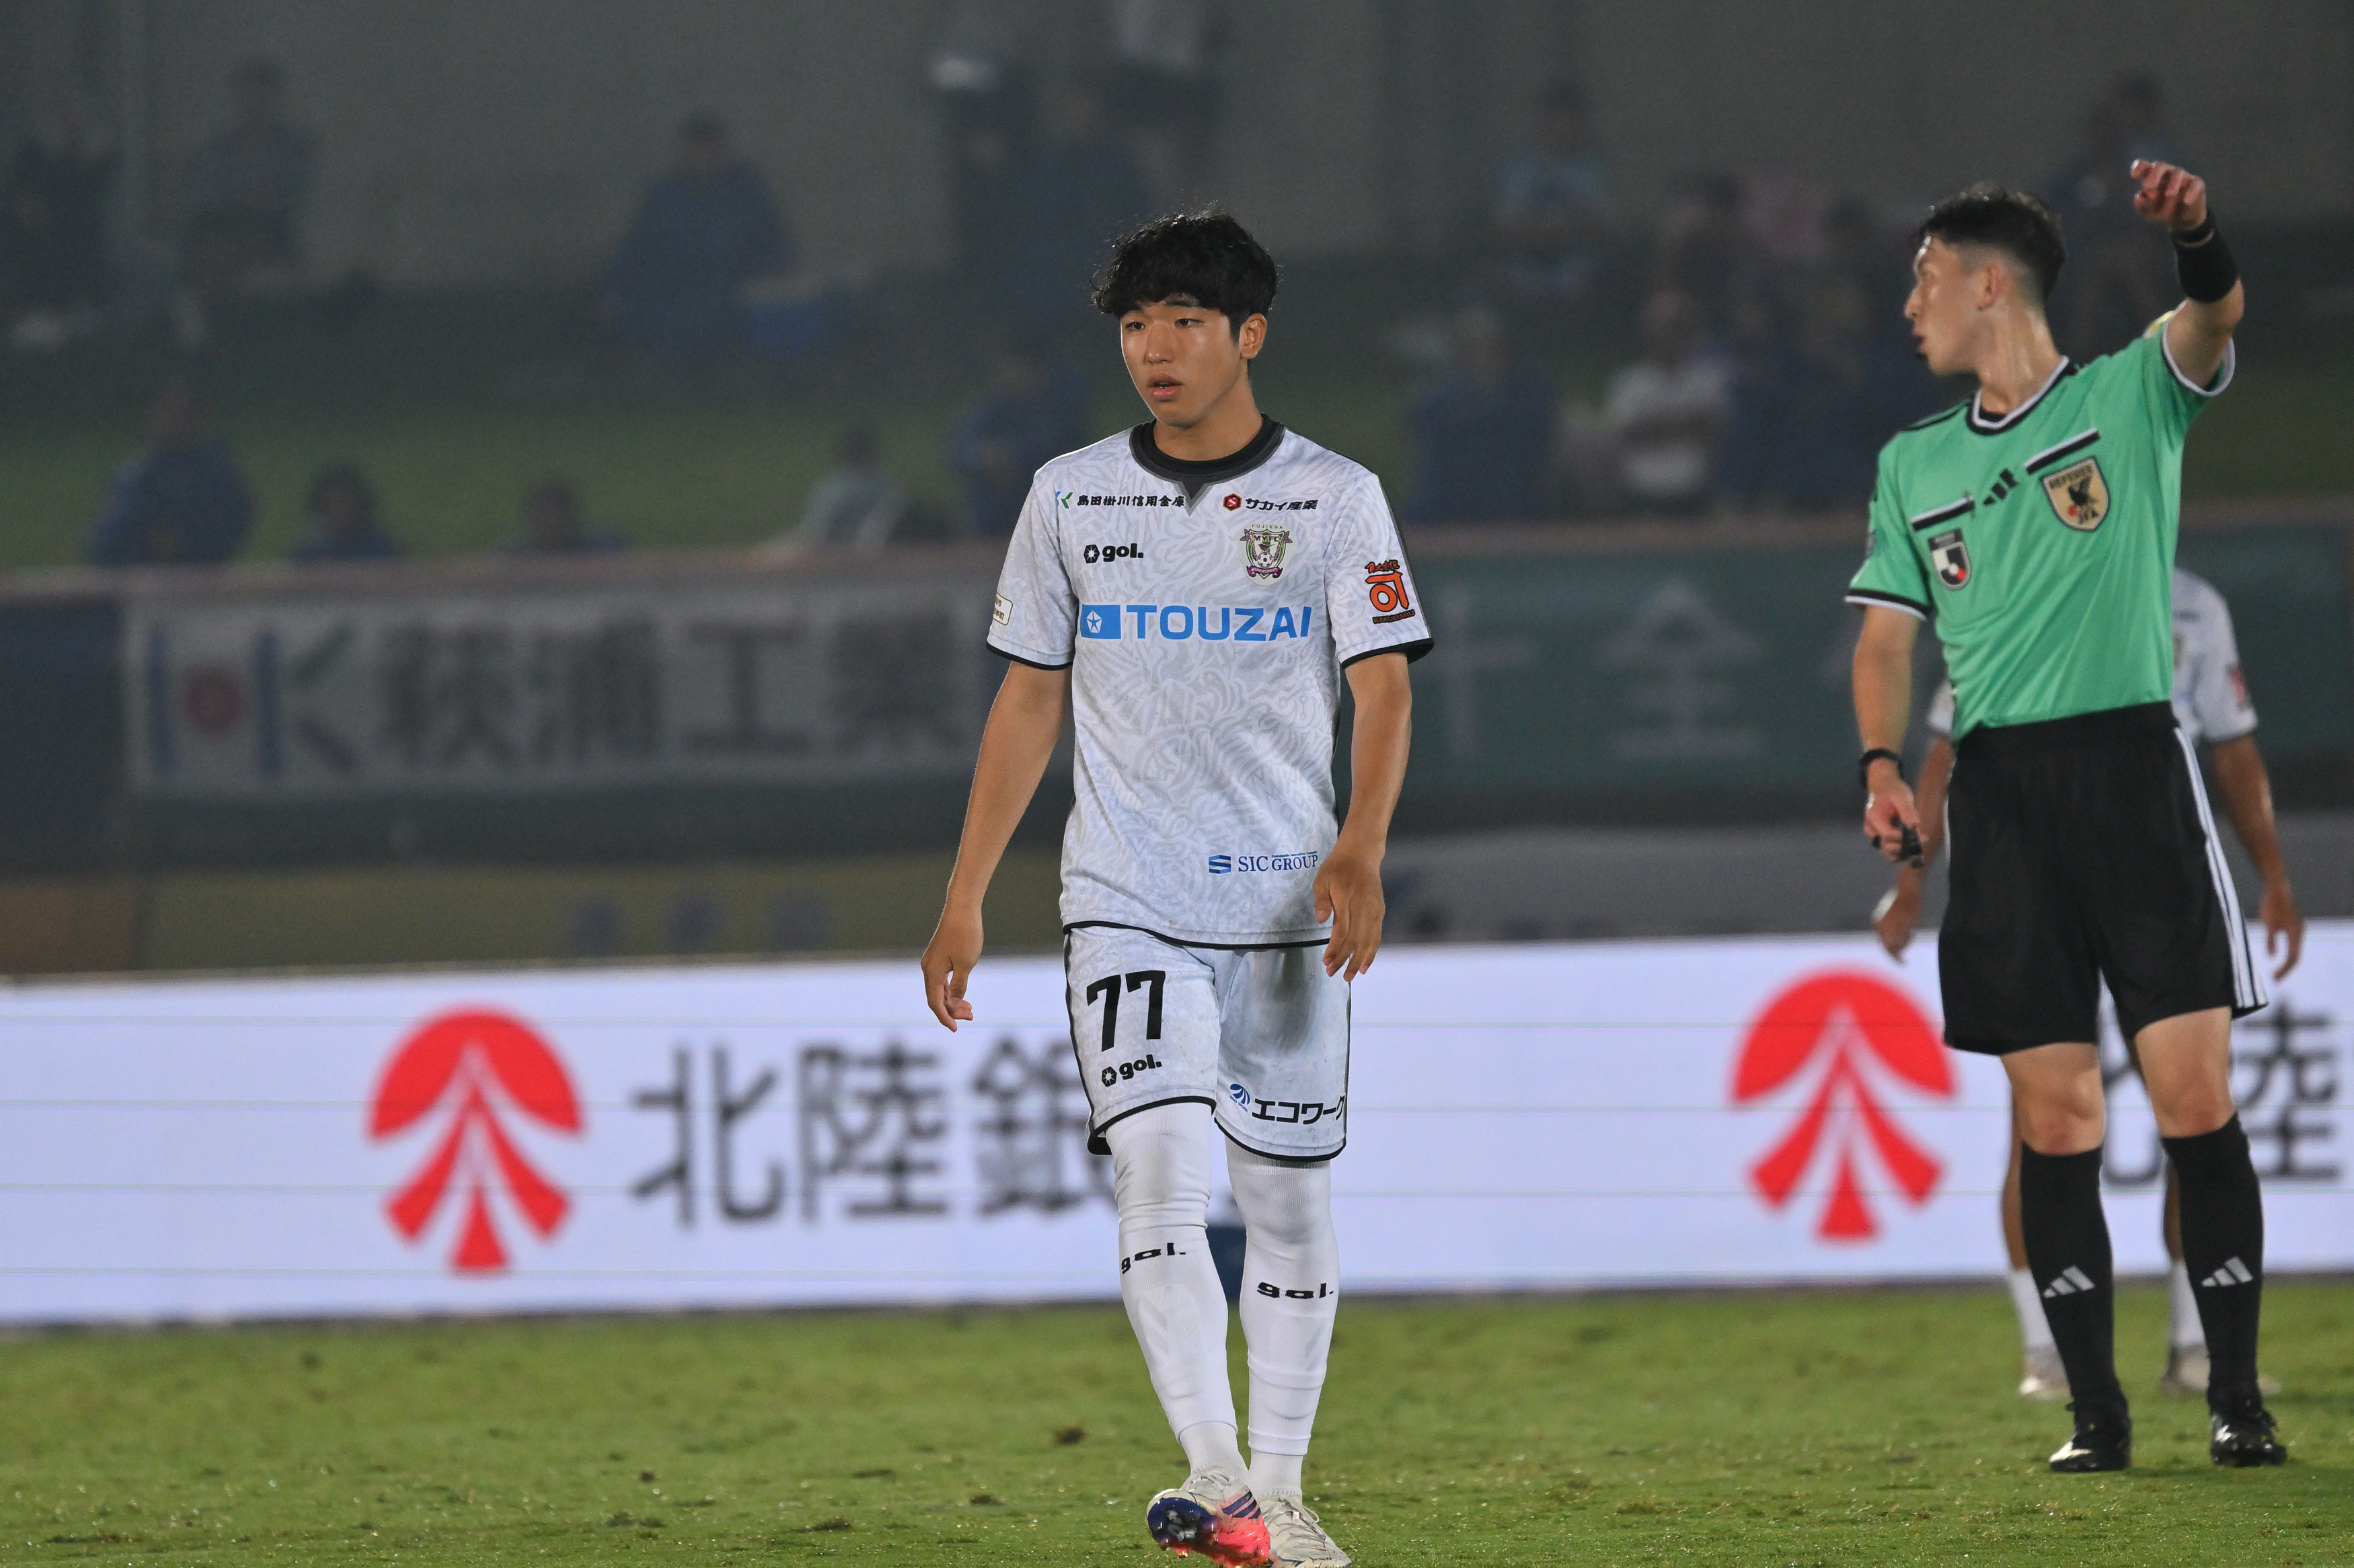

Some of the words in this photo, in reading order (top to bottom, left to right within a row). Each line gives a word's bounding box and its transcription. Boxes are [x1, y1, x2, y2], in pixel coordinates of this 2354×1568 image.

[1077, 495, 1185, 507] 島田掛川信用金庫
[1245, 498, 1319, 511] サカイ産業
[1102, 543, 1144, 562] gol.
[1126, 604, 1312, 641] TOUZAI
[1373, 611, 1414, 623] KAKUMARU
[1238, 856, 1269, 872] SIC
[1271, 855, 1318, 871] GROUP
[1086, 970, 1166, 1052] 77
[1119, 1054, 1163, 1080] gol.
[631, 1039, 1244, 1225] 北陸銀
[1121, 1243, 1186, 1274] gol.
[1256, 1282, 1334, 1299] gol.
